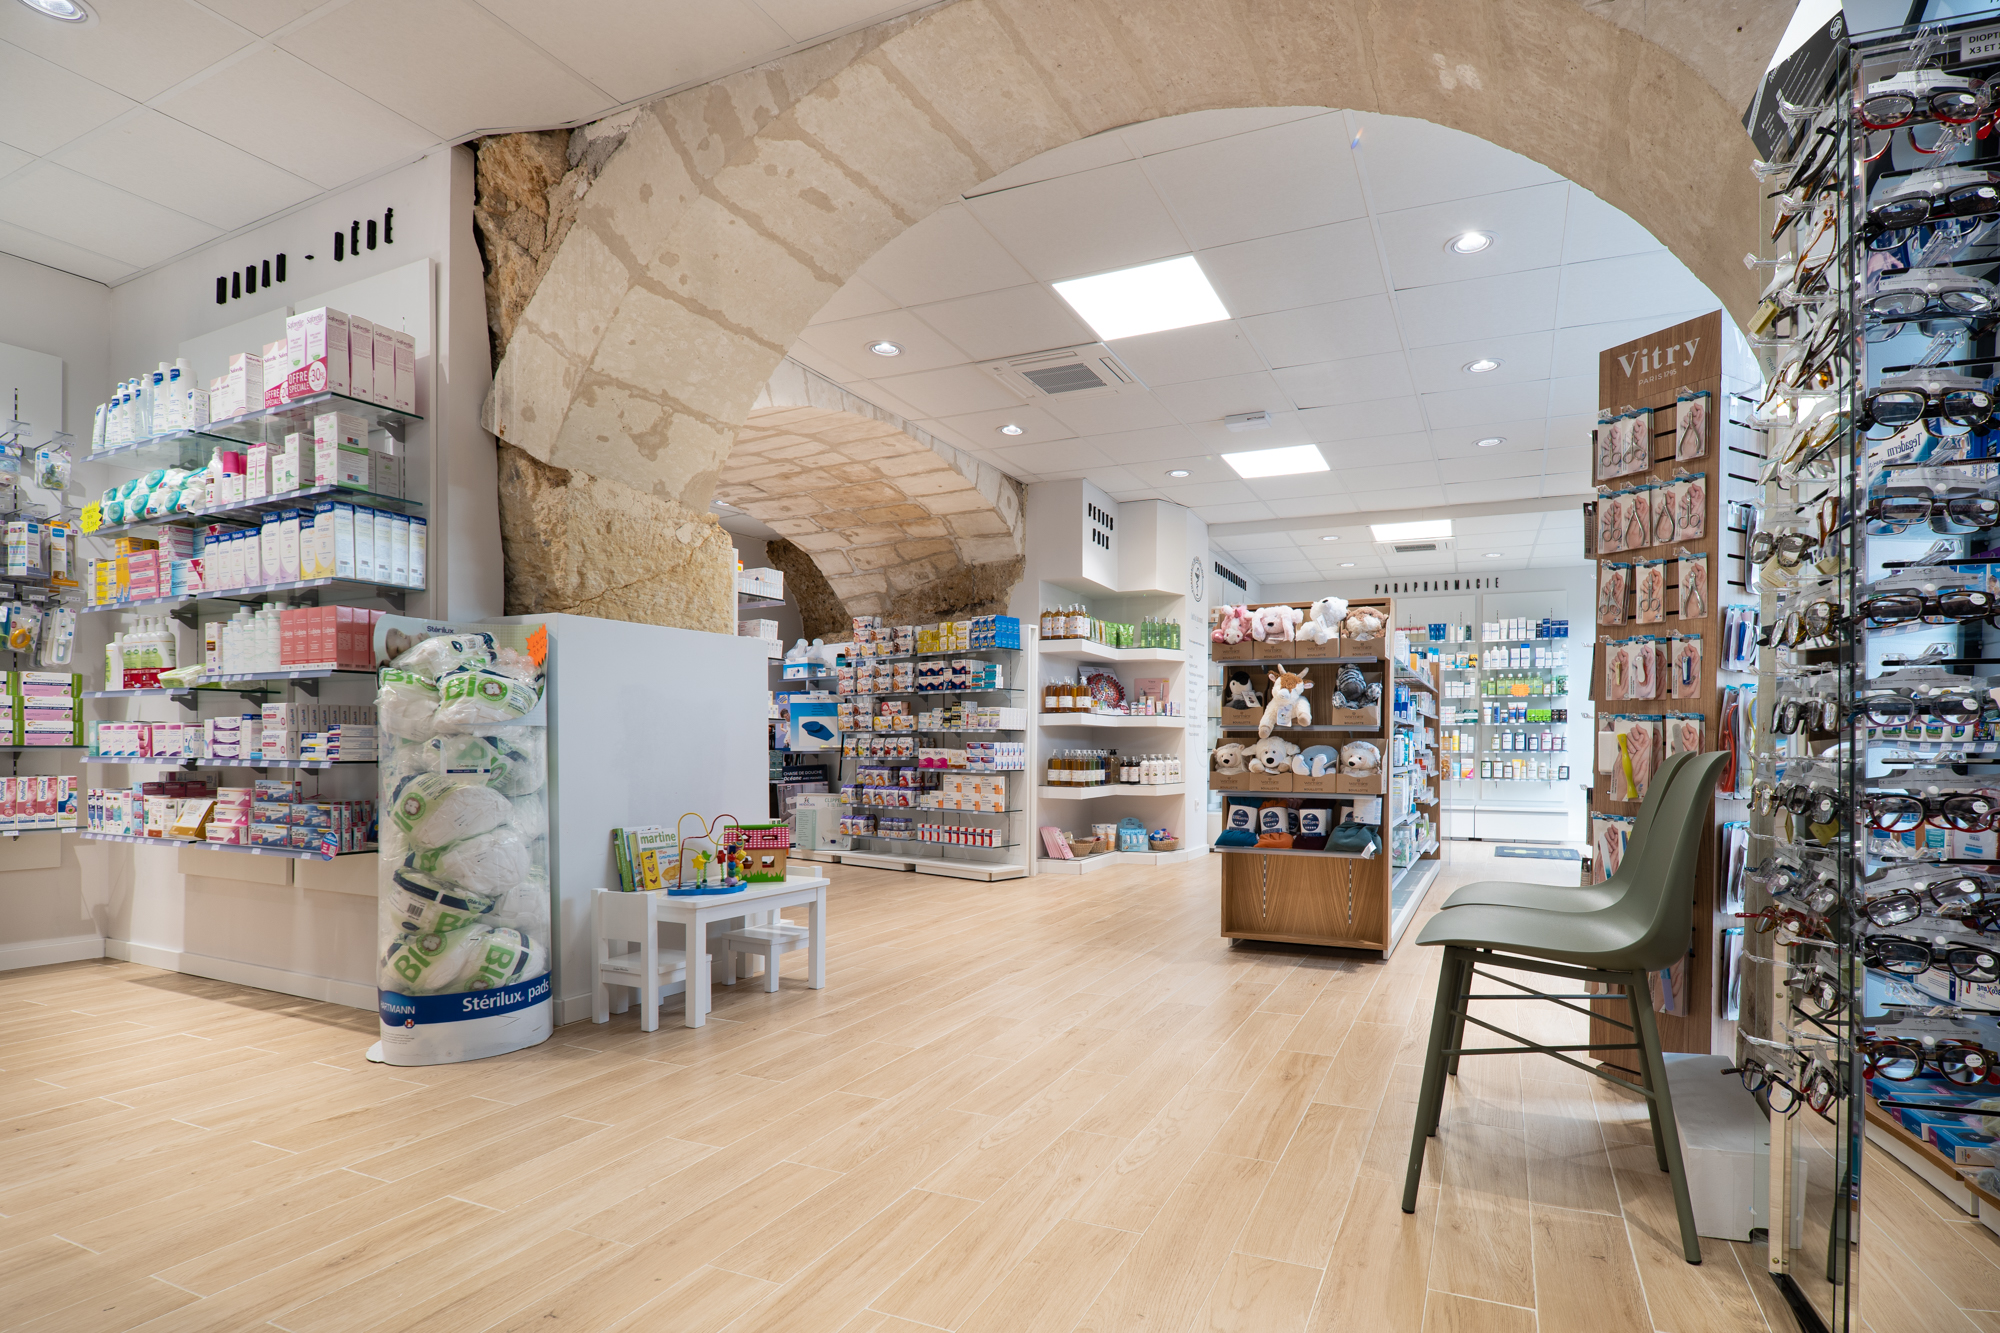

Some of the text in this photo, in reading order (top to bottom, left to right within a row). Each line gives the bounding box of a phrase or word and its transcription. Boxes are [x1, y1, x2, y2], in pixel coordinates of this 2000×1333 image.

[1969, 32, 2000, 44] DIOPT
[1970, 44, 1996, 54] X3 ET
[216, 253, 286, 304] MAMAN
[334, 207, 394, 262] BÉBÉ
[1618, 337, 1700, 378] Vitry
[288, 370, 308, 385] OFFRE
[309, 367, 326, 382] -30%
[1638, 368, 1677, 386] PARIS 1795
[266, 388, 280, 400] OFFRE
[288, 382, 310, 396] SPÉCIALE
[1088, 502, 1113, 531] PETITS
[1092, 528, 1109, 550] PRIX
[1374, 577, 1499, 594] PARAPHARMACIE
[427, 626, 454, 634] Stérilux
[640, 831, 676, 844] martine
[528, 979, 549, 1002] pads
